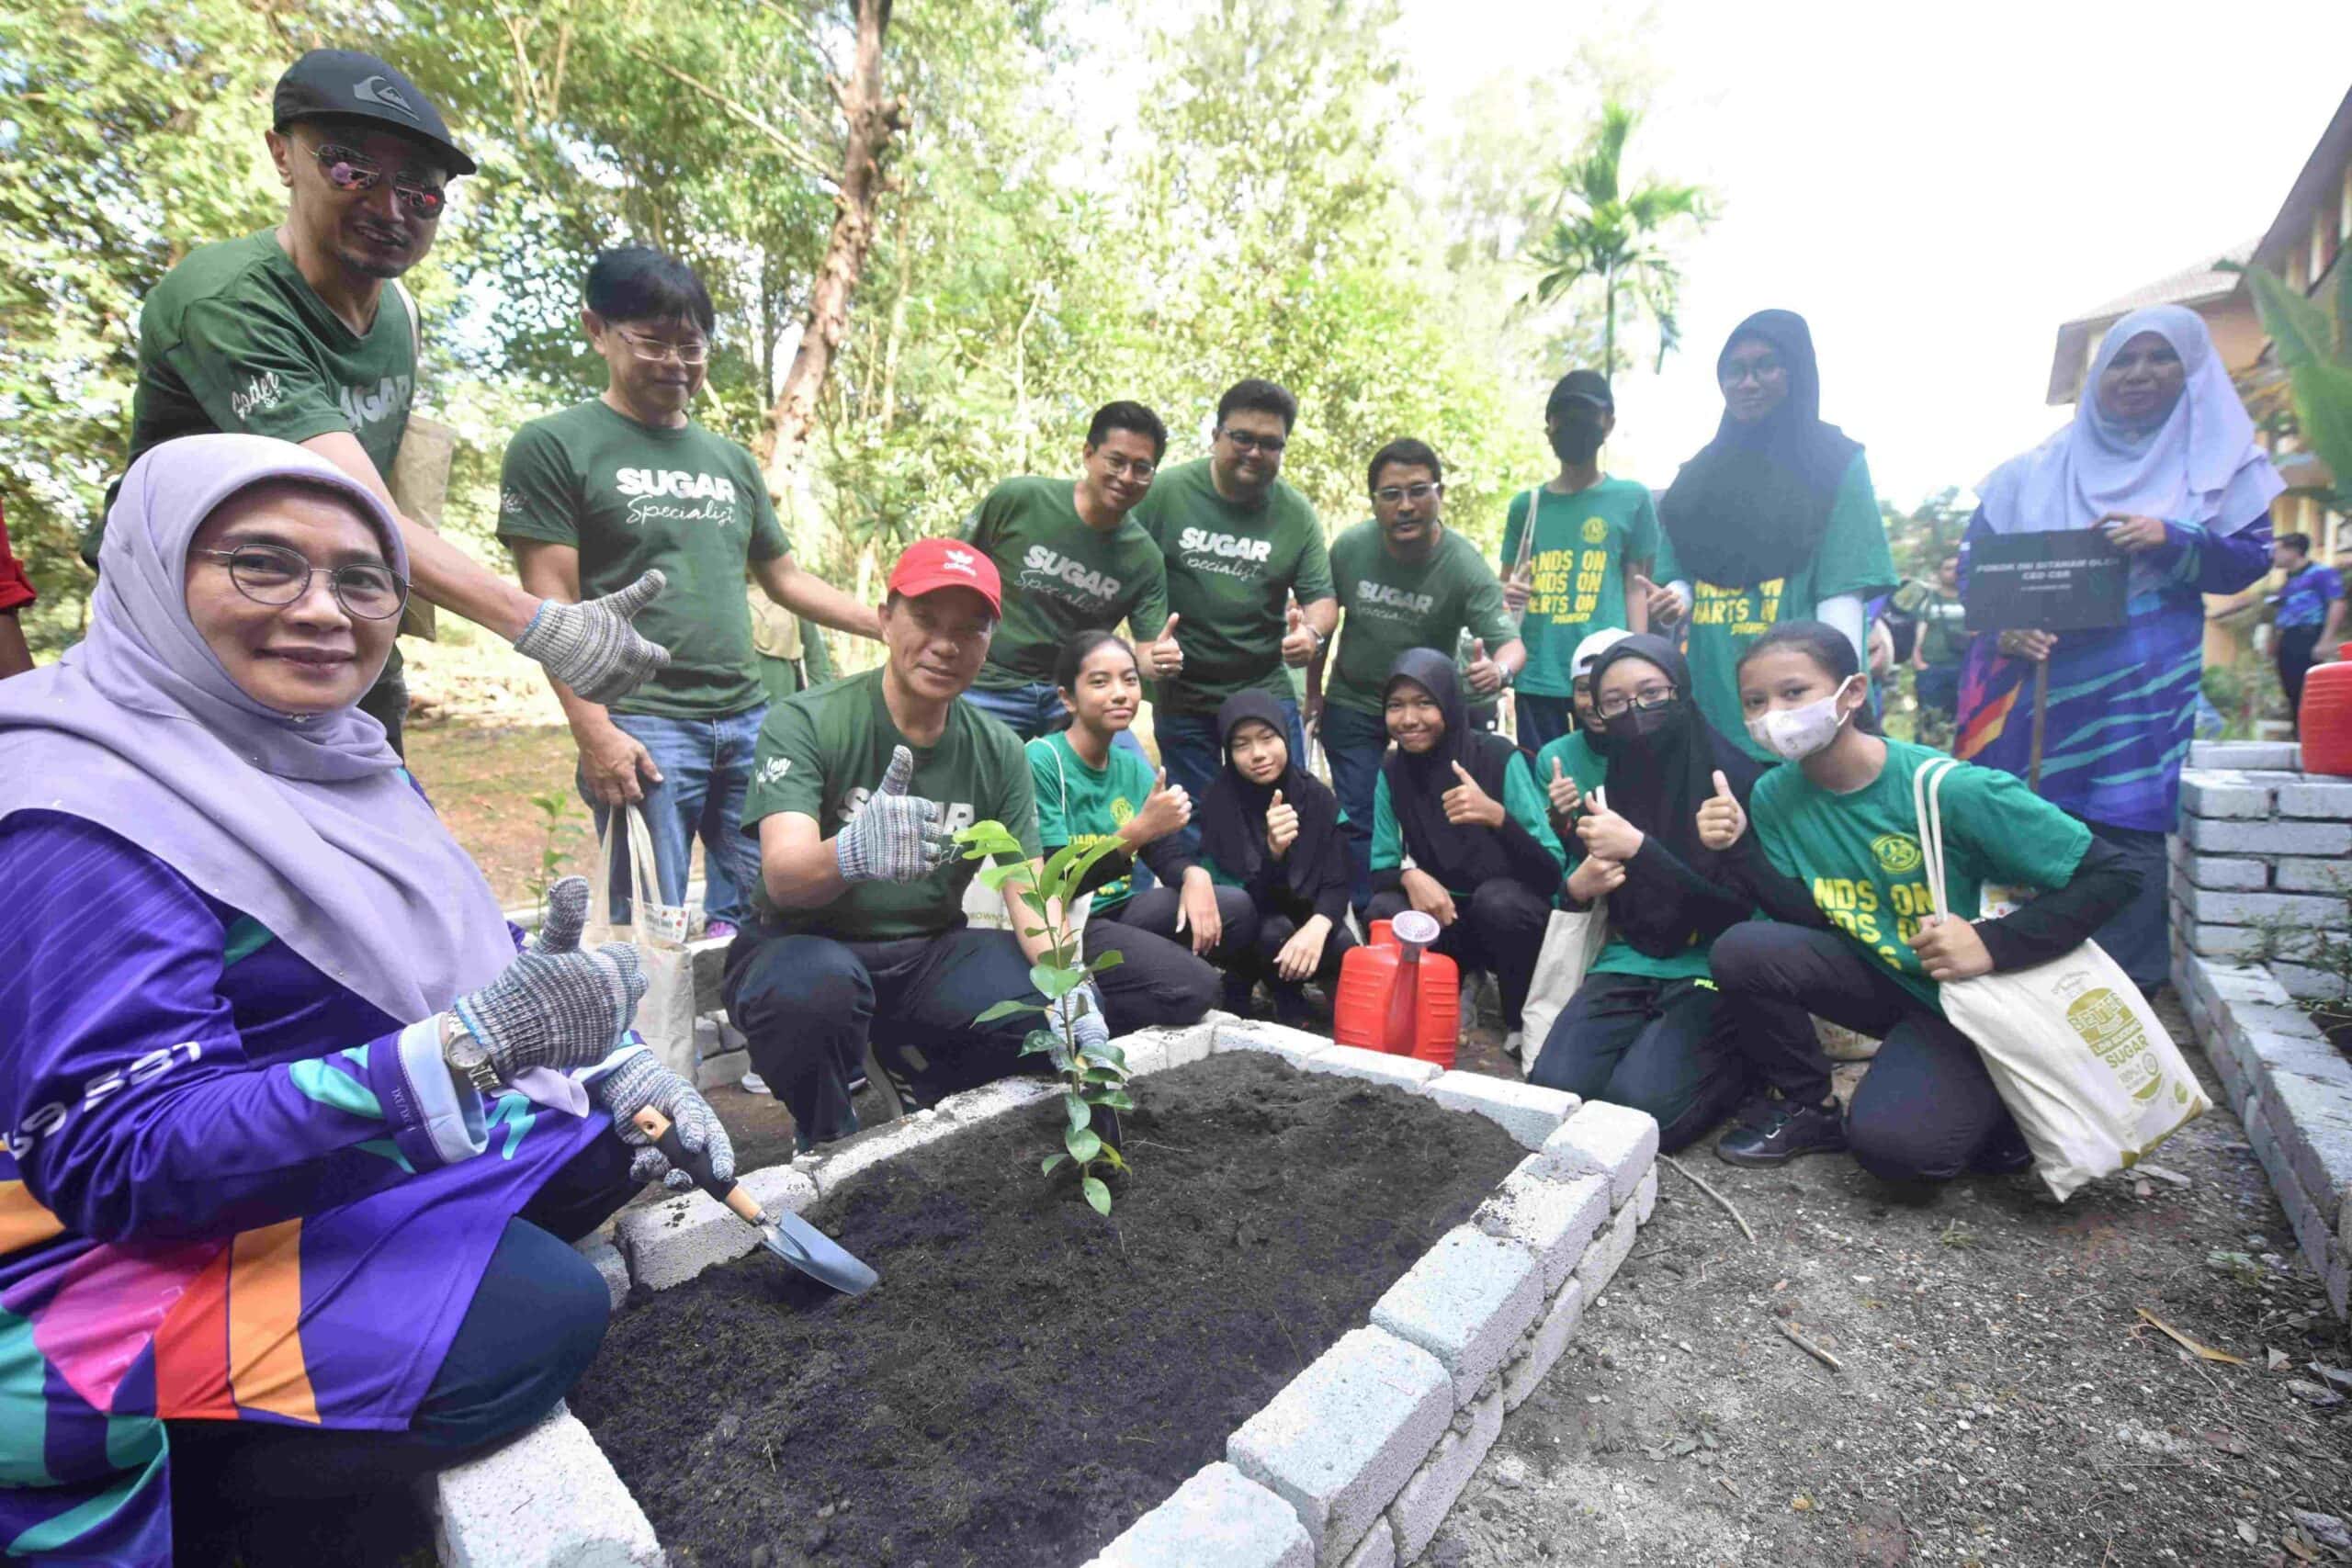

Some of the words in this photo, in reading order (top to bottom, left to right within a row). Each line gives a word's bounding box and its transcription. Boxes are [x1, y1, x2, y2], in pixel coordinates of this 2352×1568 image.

[616, 467, 736, 504] SUGAR
[1178, 526, 1272, 563] SUGAR
[1582, 549, 1607, 571] ON
[1023, 544, 1121, 602] SUGAR
[1577, 571, 1602, 592] ON
[1356, 580, 1434, 615] SUGAR
[1574, 593, 1597, 612] ON
[1813, 877, 1879, 913] NDS
[2106, 1034, 2150, 1068] SUGAR
